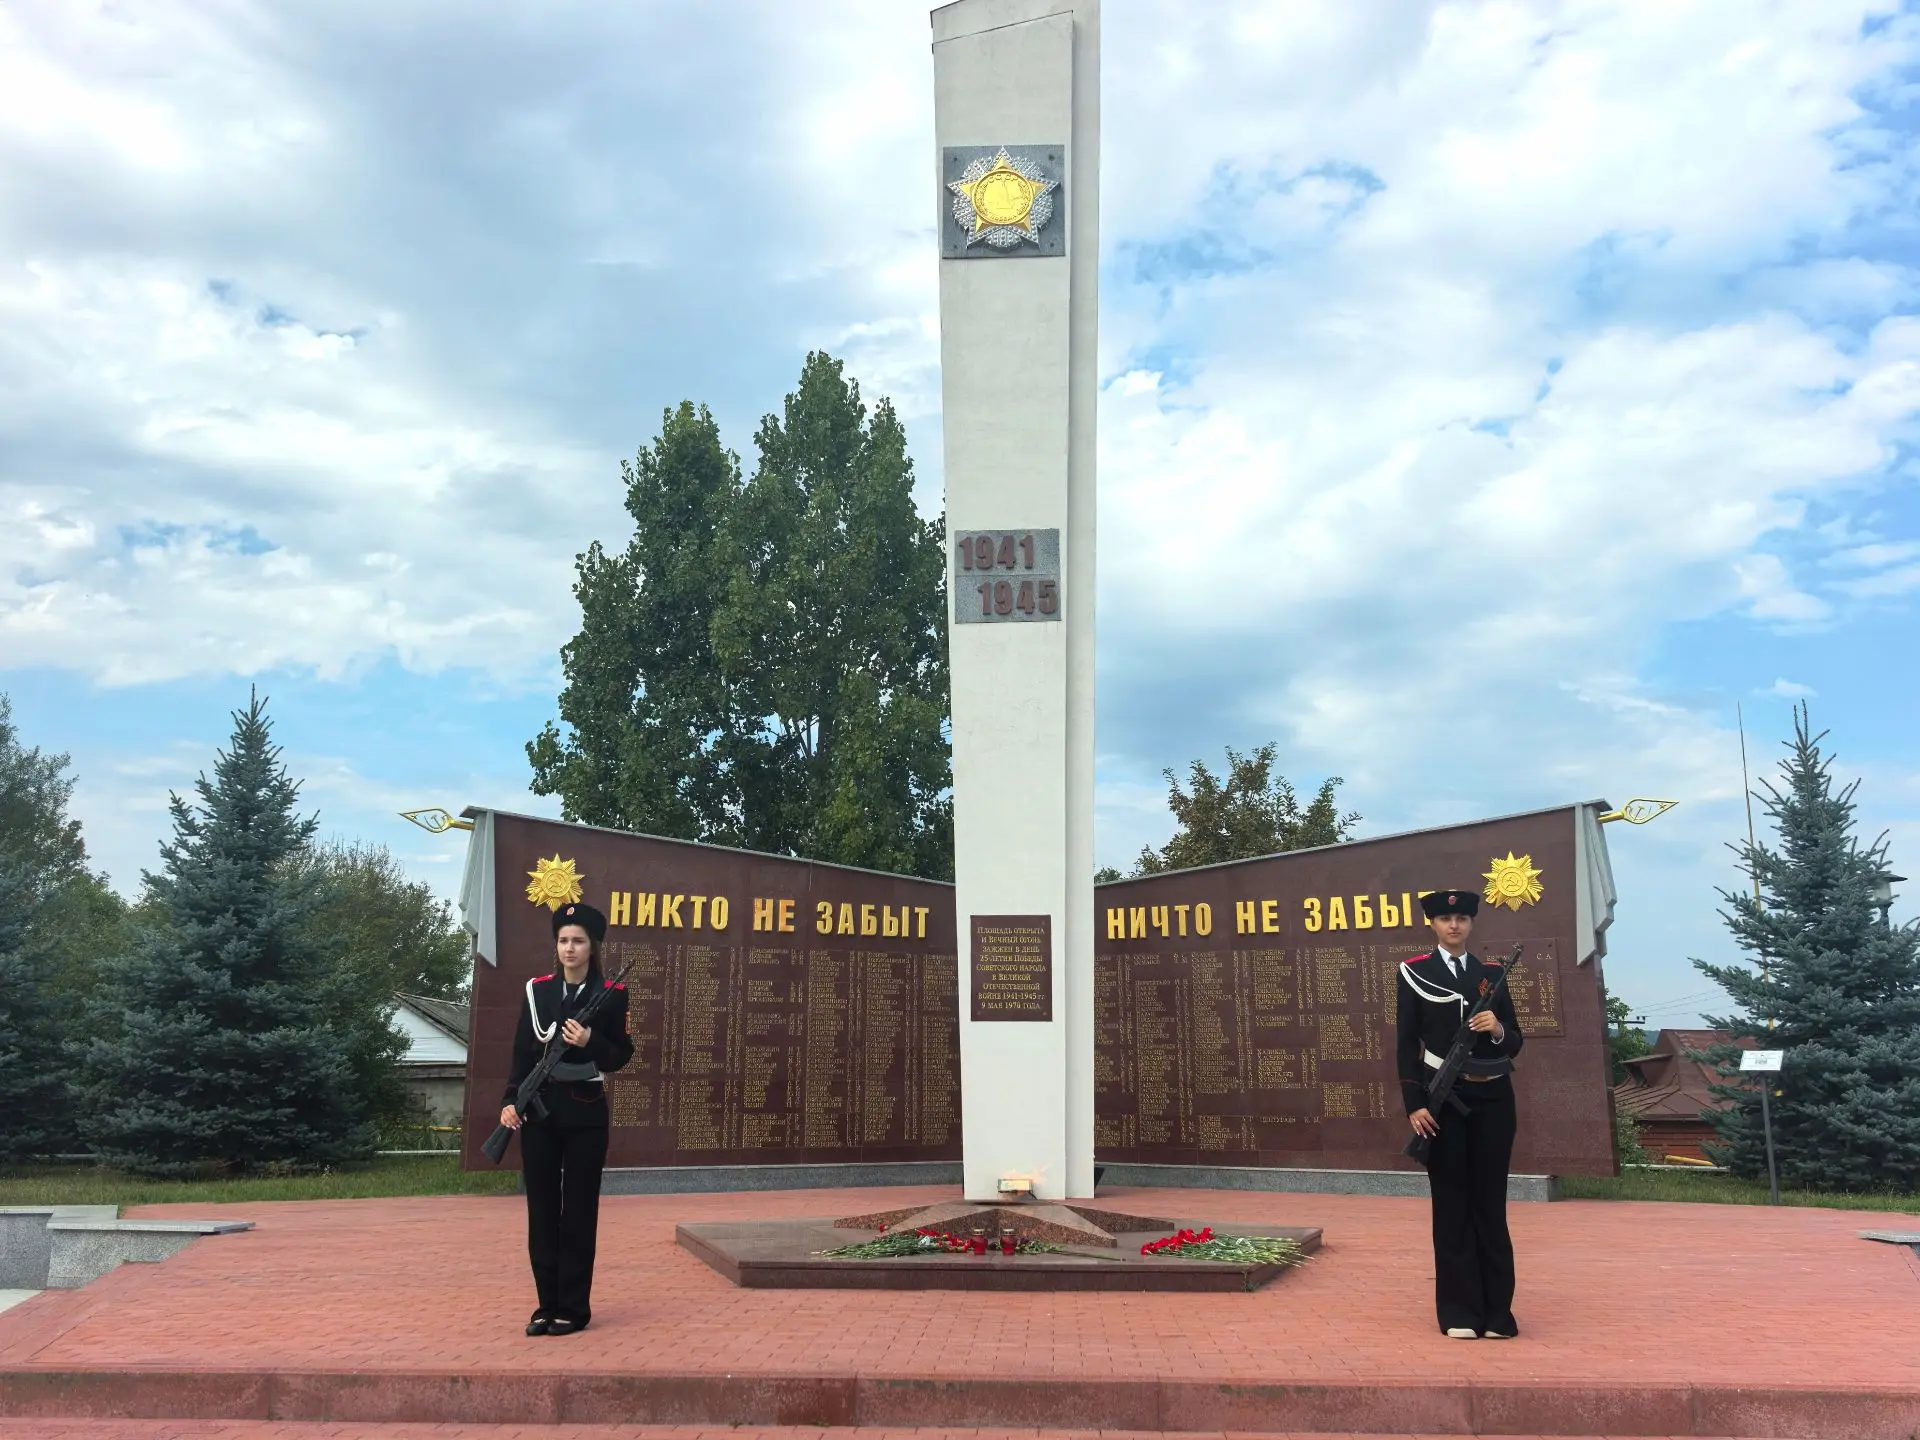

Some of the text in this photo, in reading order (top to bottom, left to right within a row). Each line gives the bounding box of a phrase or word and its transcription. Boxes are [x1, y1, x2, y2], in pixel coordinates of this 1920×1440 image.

[959, 534, 1034, 570] 1941
[978, 580, 1058, 615] 1945
[609, 891, 930, 938] НИКТО НЕ ЗАБЫТ
[1107, 902, 1212, 939] НИЧТО
[1236, 900, 1280, 934] НЕ
[1014, 955, 1043, 963] ПОБЕДЫ
